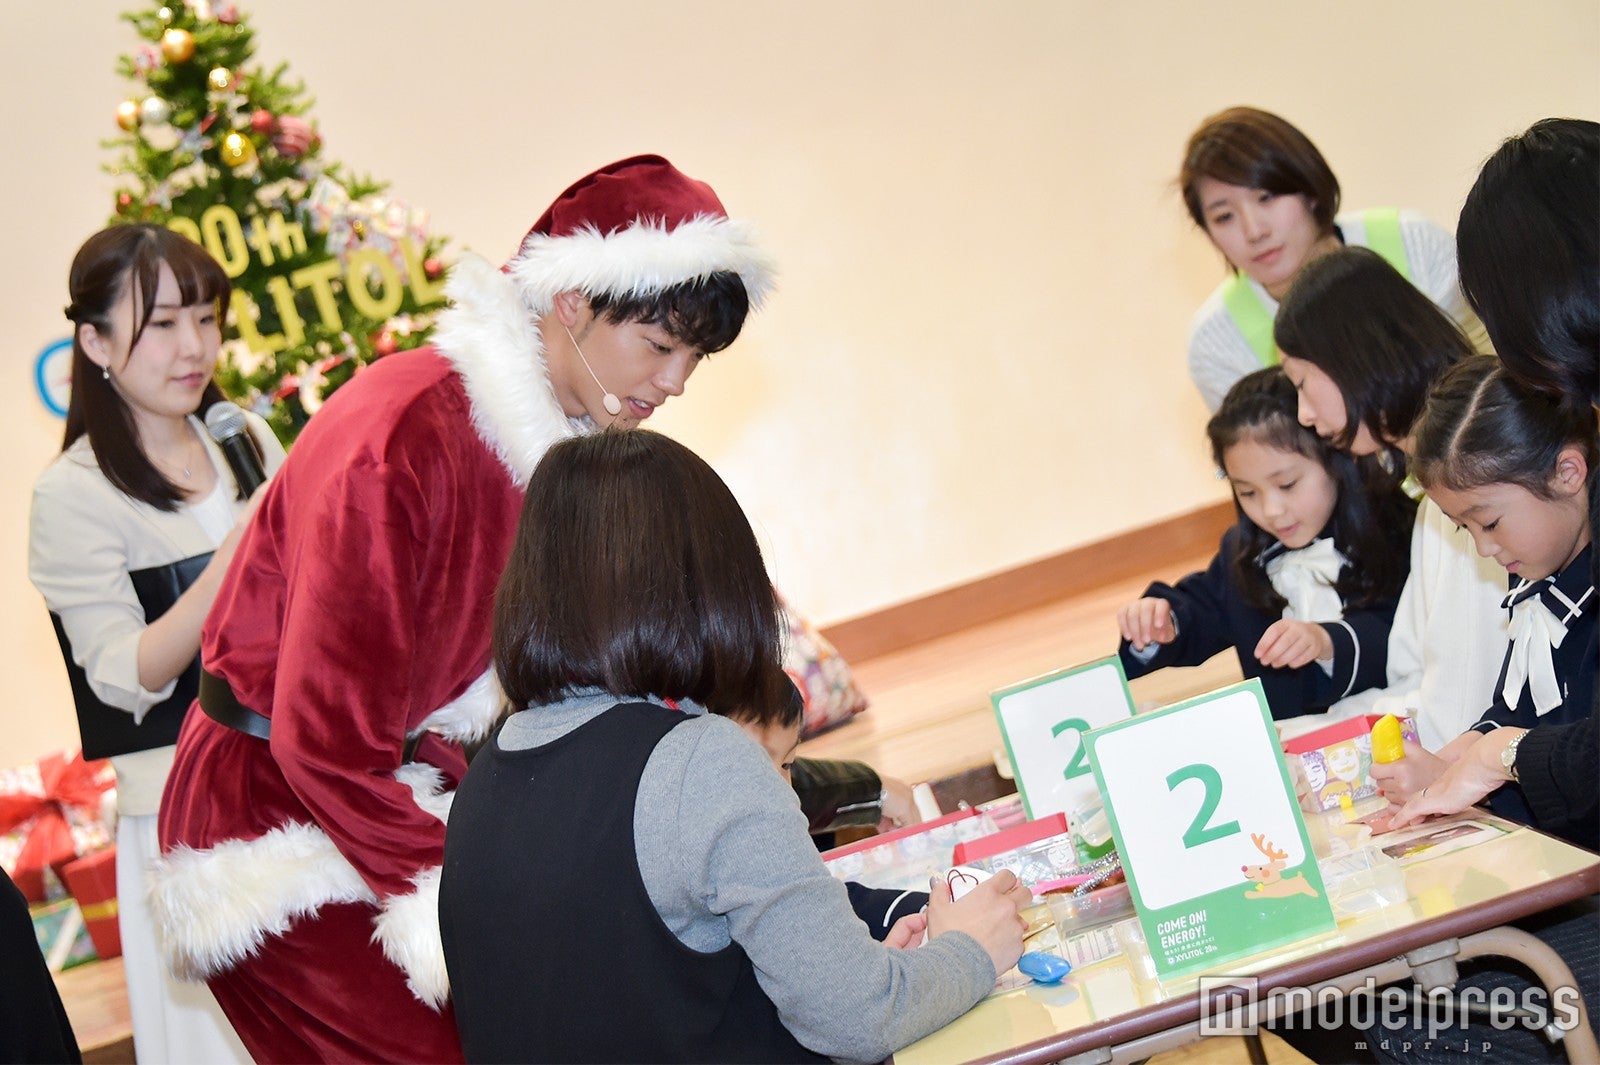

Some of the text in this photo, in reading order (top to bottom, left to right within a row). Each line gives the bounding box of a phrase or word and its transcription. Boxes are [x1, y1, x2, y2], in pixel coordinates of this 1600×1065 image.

[1051, 717, 1092, 780] 2
[1165, 763, 1242, 850] 2
[1157, 909, 1207, 936] COME ON!
[1161, 924, 1206, 949] ENERGY!
[1175, 948, 1205, 963] XYLITOL
